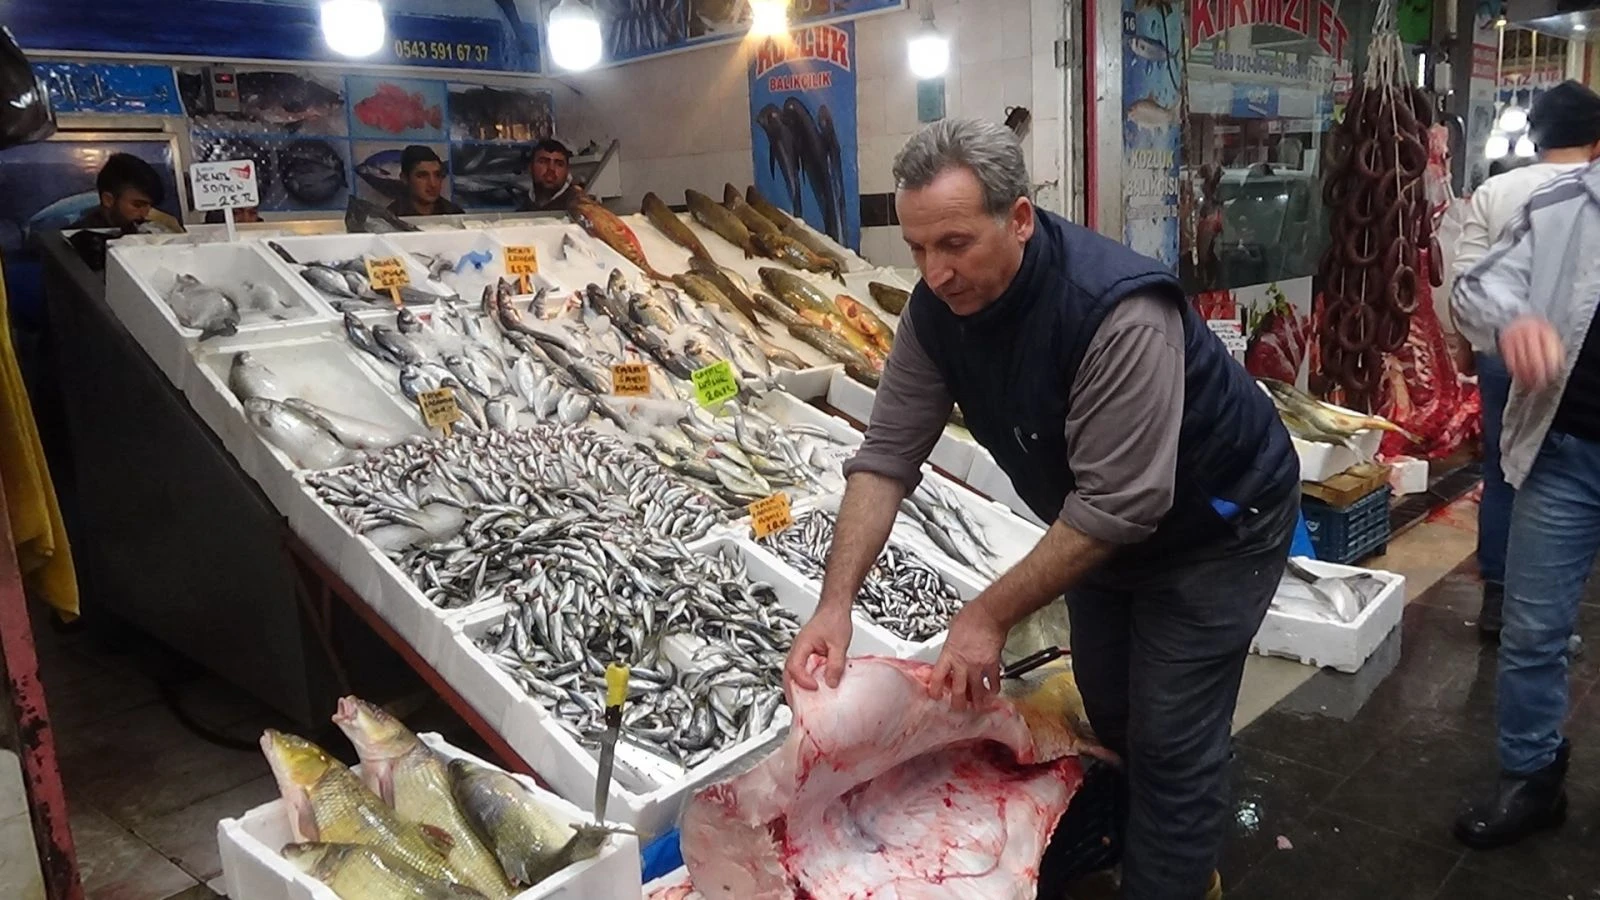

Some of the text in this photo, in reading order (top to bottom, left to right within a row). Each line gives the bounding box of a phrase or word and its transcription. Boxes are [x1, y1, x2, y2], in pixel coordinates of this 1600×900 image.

[1124, 16, 1136, 31] 16
[1319, 0, 1349, 67] ET
[395, 40, 488, 62] 0543 591 67 37
[769, 71, 833, 93] BALIKÇILIK
